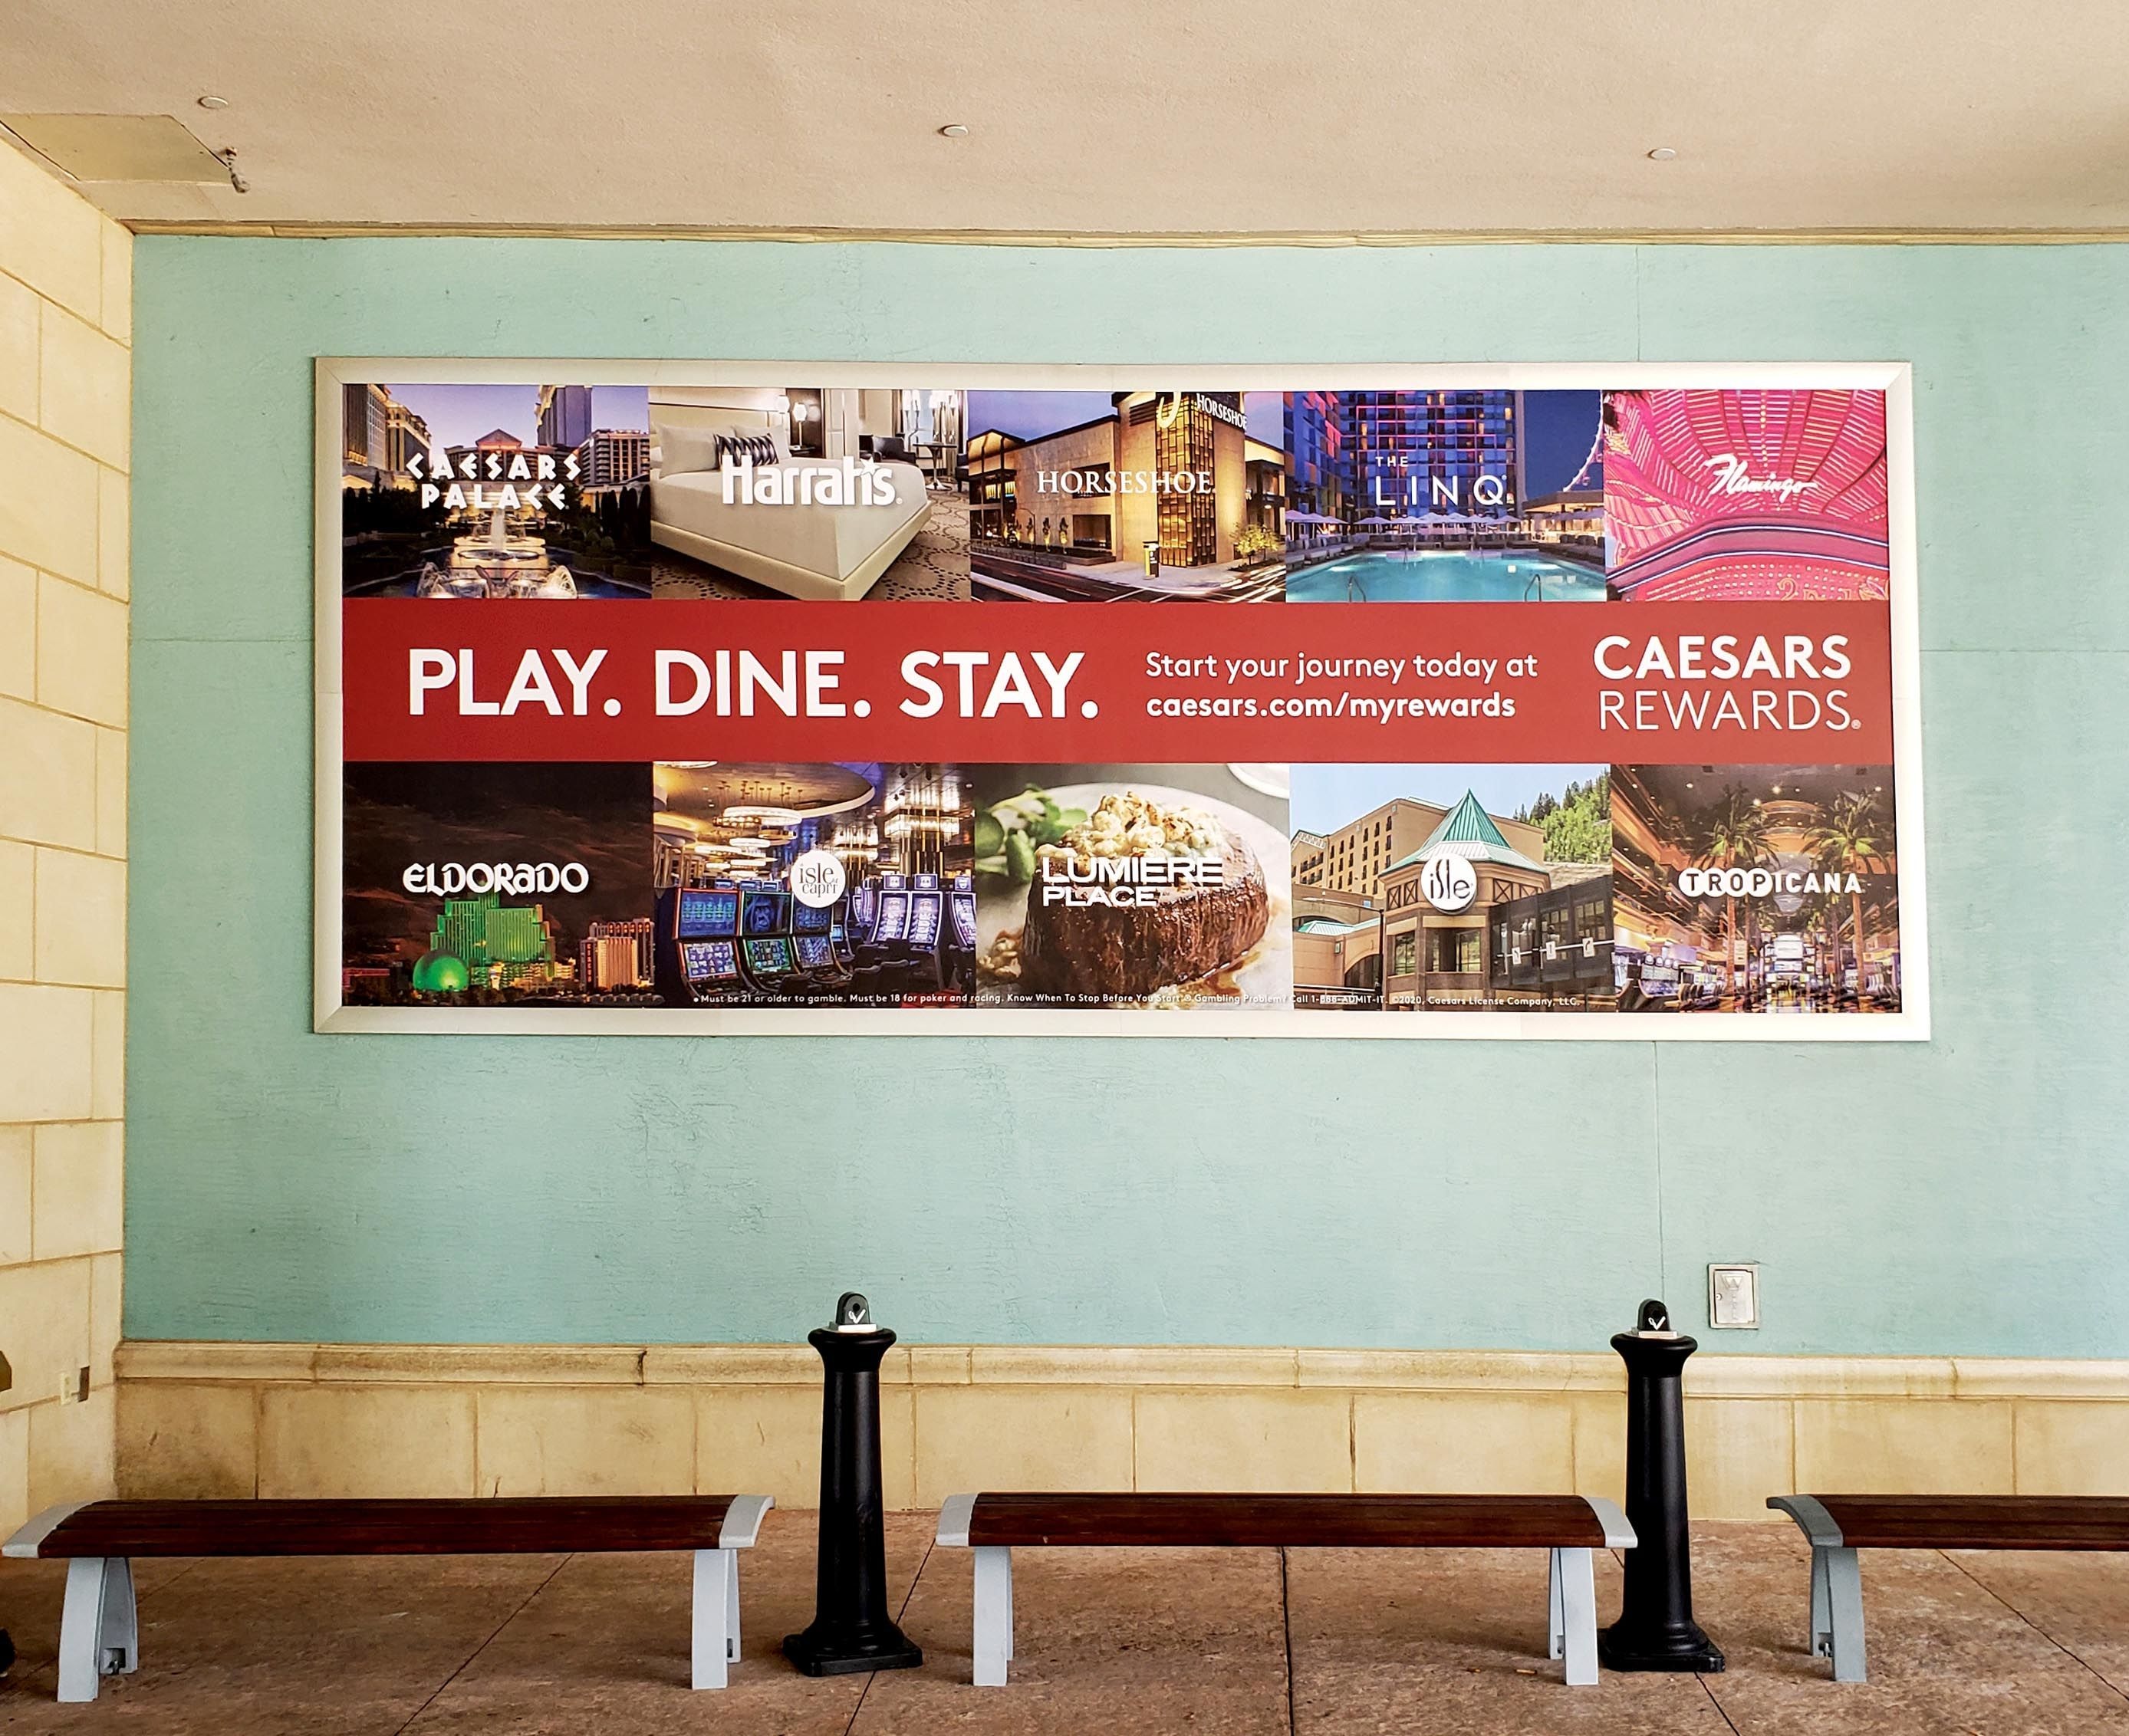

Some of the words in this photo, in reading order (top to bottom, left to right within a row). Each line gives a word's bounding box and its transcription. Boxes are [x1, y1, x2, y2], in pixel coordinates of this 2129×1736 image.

[1196, 393, 1247, 430] HORSESHOE
[406, 452, 581, 481] CAESARS
[1375, 456, 1409, 467] THE
[1037, 471, 1213, 494] HORSESHOE
[1375, 475, 1504, 506] LINQ
[1704, 453, 1818, 504] Flamingo
[421, 483, 565, 510] PALACE
[1146, 652, 1218, 678] Start
[1225, 656, 1289, 684] your
[1295, 652, 1406, 684] journey
[1412, 652, 1498, 684] today
[1505, 655, 1538, 678] at
[1593, 635, 1851, 680] CAESARS
[410, 649, 621, 717] PLAY.
[655, 649, 872, 718] DINE.
[899, 650, 1099, 719] STAY.
[1146, 692, 1517, 724] caesars.com/myrewards
[1599, 689, 1851, 731] REWARDS
[403, 863, 589, 896] ELDORADO
[799, 863, 834, 883] isle
[1430, 859, 1471, 899] isle
[1679, 868, 1862, 897] TROPICANA
[1042, 886, 1157, 906] PLACE
[808, 995, 847, 1004] gamble.
[903, 994, 917, 1002] for
[920, 995, 947, 1004] poker
[970, 994, 1005, 1004] racing.
[1007, 994, 1034, 1002] Know
[1035, 994, 1062, 1002] When
[1078, 994, 1100, 1004] Stop
[1103, 994, 1133, 1002] Before
[1136, 994, 1153, 1002] You
[1194, 994, 1240, 1004] Gambling
[1243, 995, 1286, 1003] Problem?
[1292, 995, 1308, 1003] Call
[1427, 996, 1466, 1005] Caesars
[1469, 997, 1504, 1005] License
[1507, 997, 1556, 1007] Company,
